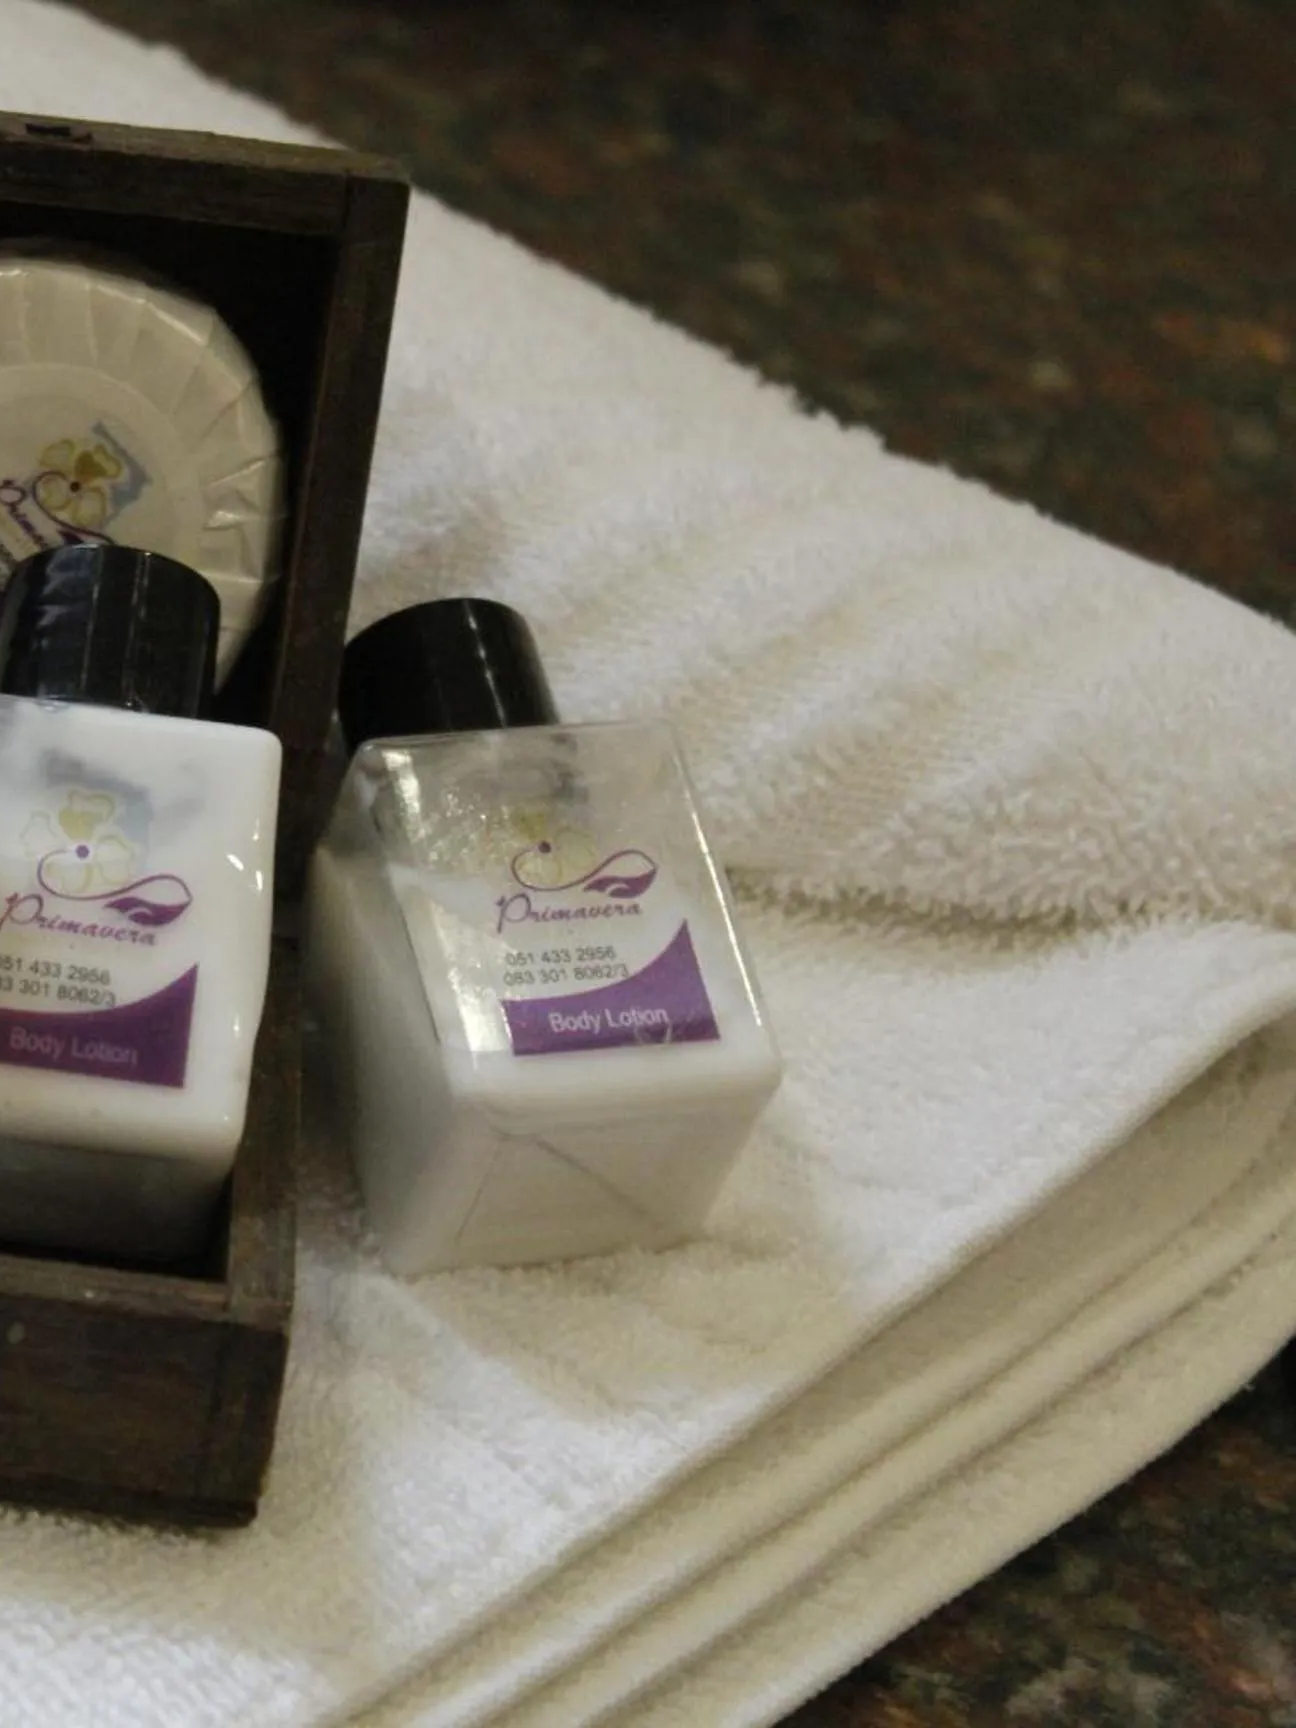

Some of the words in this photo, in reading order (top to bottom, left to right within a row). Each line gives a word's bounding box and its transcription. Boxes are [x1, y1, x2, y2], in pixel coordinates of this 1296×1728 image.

[495, 893, 643, 934] Primavera
[505, 951, 535, 967] 051
[541, 949, 571, 964] 433
[575, 945, 617, 962] 2956
[29, 959, 62, 978] 433
[67, 964, 111, 986] 2956
[504, 970, 535, 986] 083
[540, 968, 568, 984] 301
[19, 979, 51, 997] 301
[549, 1009, 602, 1035] Body
[605, 1006, 670, 1028] Lotion
[10, 1025, 66, 1061] Body
[71, 1036, 138, 1067] Lotion
